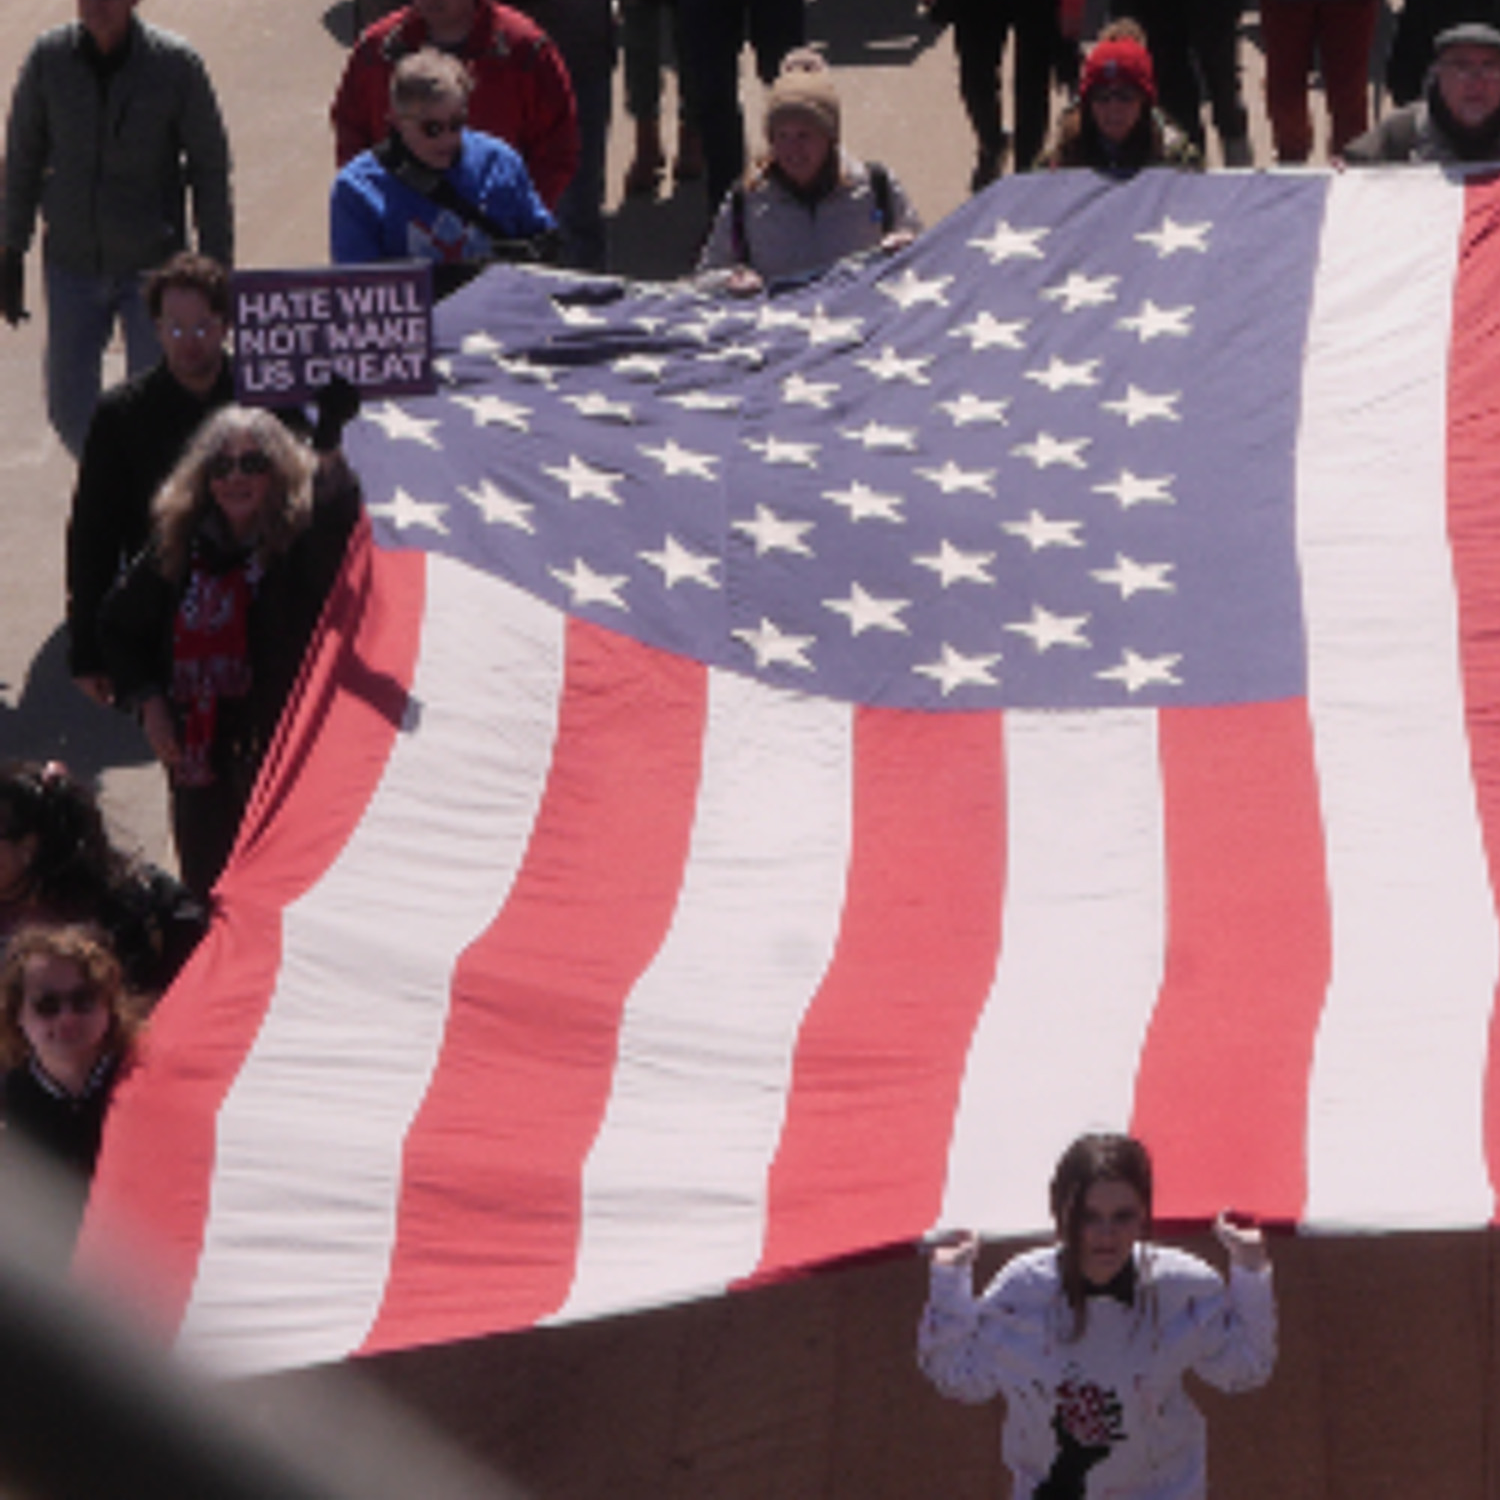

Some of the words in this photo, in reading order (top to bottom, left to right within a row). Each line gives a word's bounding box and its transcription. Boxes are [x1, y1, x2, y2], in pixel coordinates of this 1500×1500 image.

[238, 287, 331, 324] HATE
[335, 281, 423, 316] WILL
[238, 324, 319, 356] NOT
[325, 317, 427, 350] MAKE
[244, 358, 295, 391] US
[305, 352, 425, 386] GREAT
